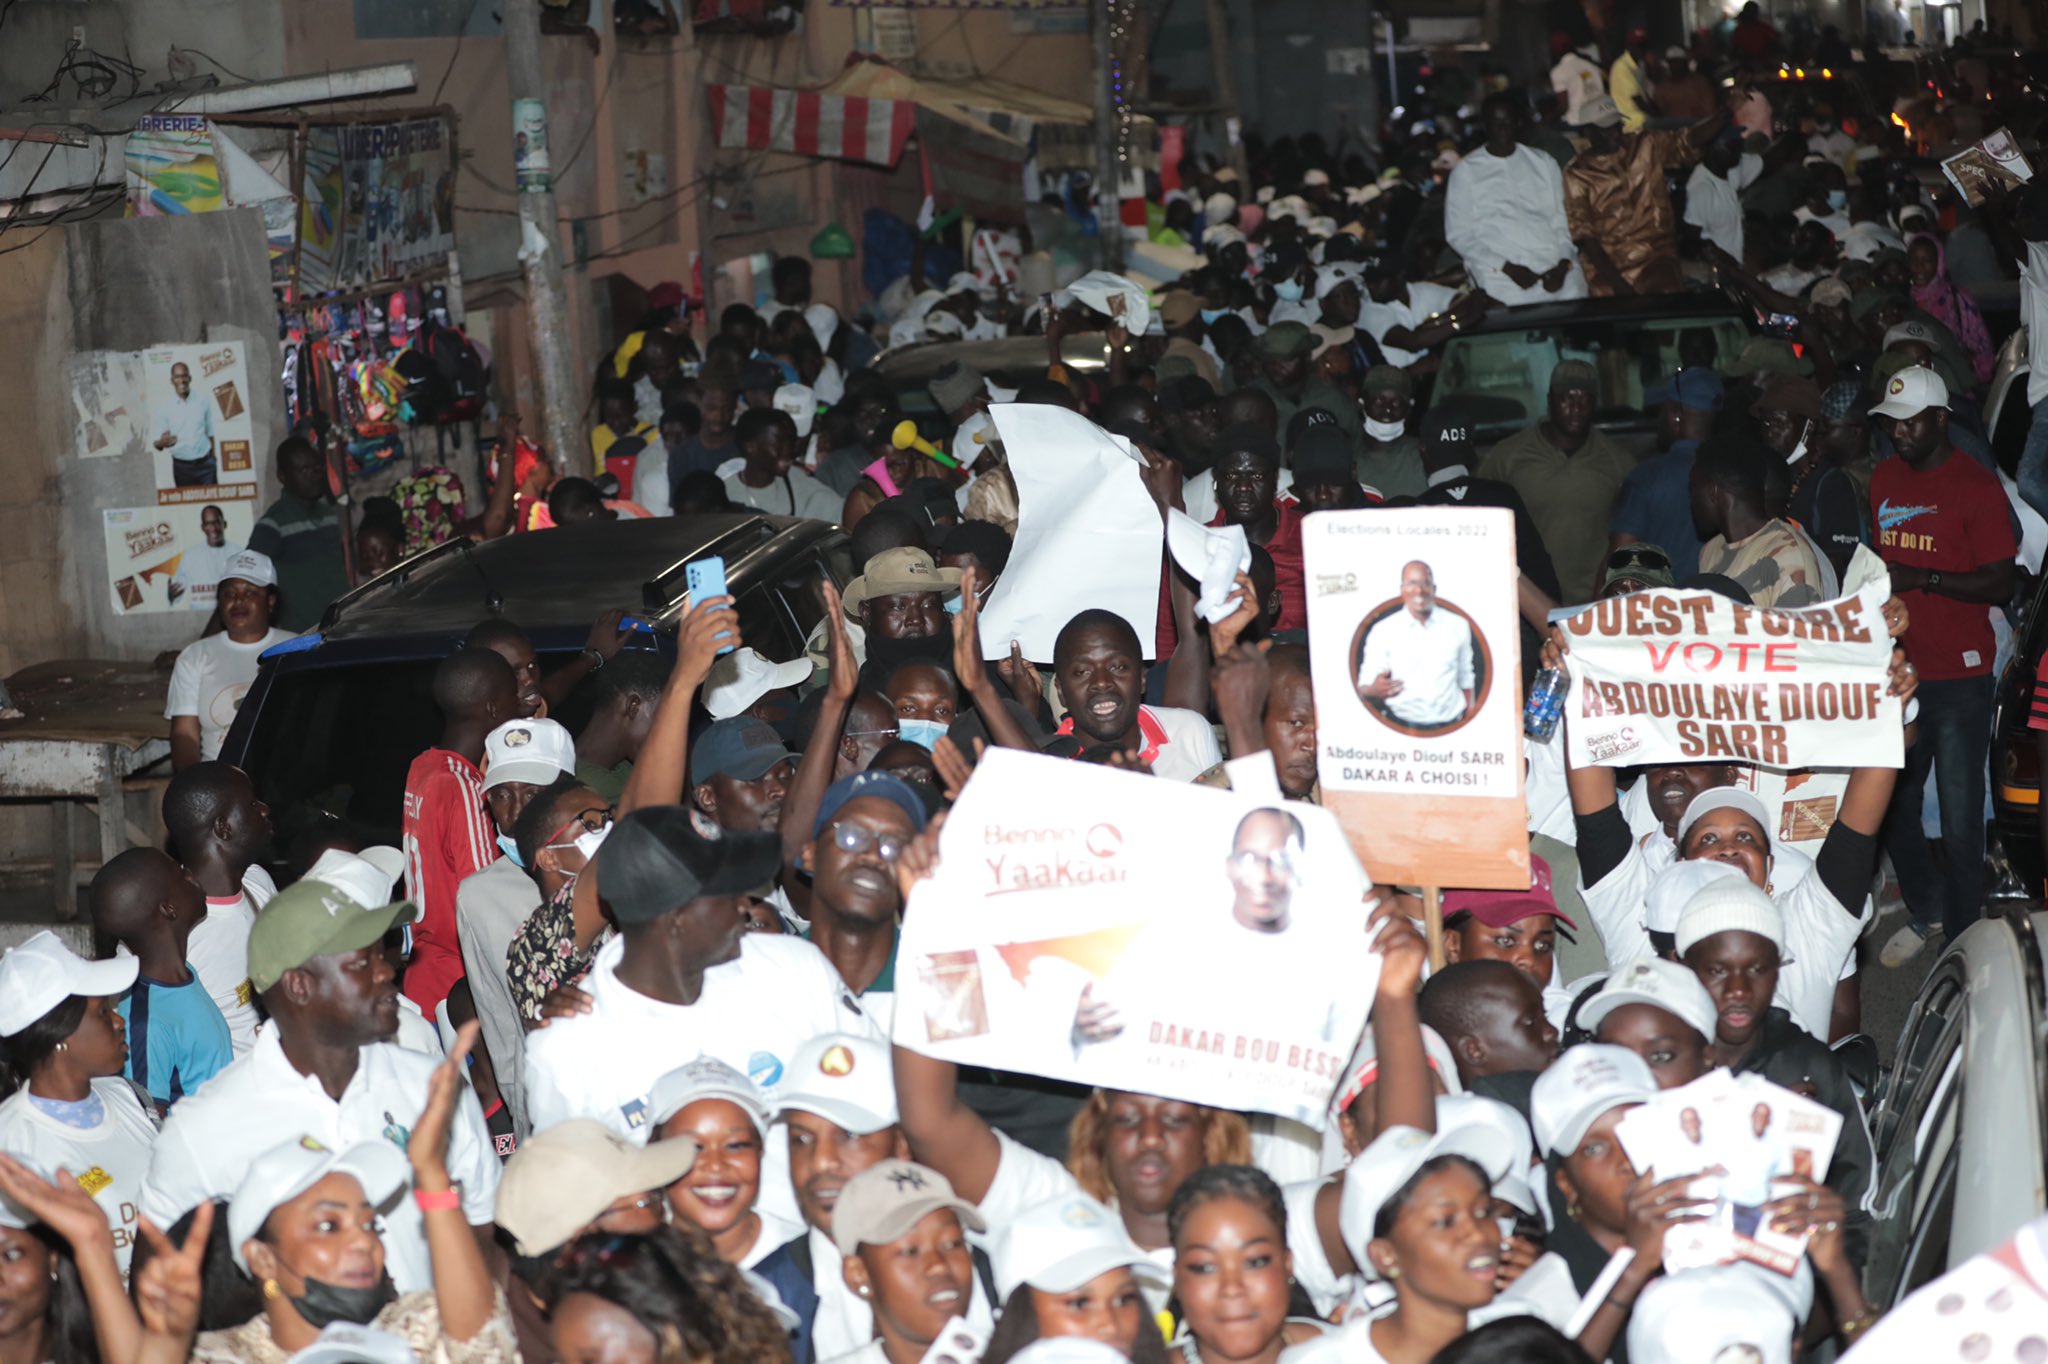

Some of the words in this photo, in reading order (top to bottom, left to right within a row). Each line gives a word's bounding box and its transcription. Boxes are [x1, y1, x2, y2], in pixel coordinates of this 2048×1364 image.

[1961, 163, 1986, 179] SPEC
[1440, 427, 1466, 441] ADS
[1328, 523, 1390, 534] Elections
[1397, 523, 1450, 535] Locales
[1457, 524, 1488, 536] 2022
[1901, 532, 1917, 549] DO
[1919, 534, 1937, 552] IT.
[1567, 593, 1714, 636] OUEST
[1642, 641, 1798, 673] VOTE
[1581, 677, 1771, 721] ABDOULAYE
[1778, 682, 1881, 722] DIOUF
[1587, 732, 1618, 746] Benno
[1676, 720, 1788, 765] SARR
[1326, 746, 1406, 764] Abdoulaye
[1413, 749, 1453, 763] Diouf
[1460, 752, 1504, 765] SARR
[1590, 740, 1640, 759] Yaakaar
[1343, 767, 1398, 782] DAKAR
[1405, 770, 1414, 783] A
[1421, 771, 1478, 785] CHOISI
[985, 850, 1127, 887] Yaakaar
[1149, 1021, 1225, 1054] DAKAR
[1234, 1035, 1281, 1065] BOU
[1287, 1045, 1341, 1081] BESS
